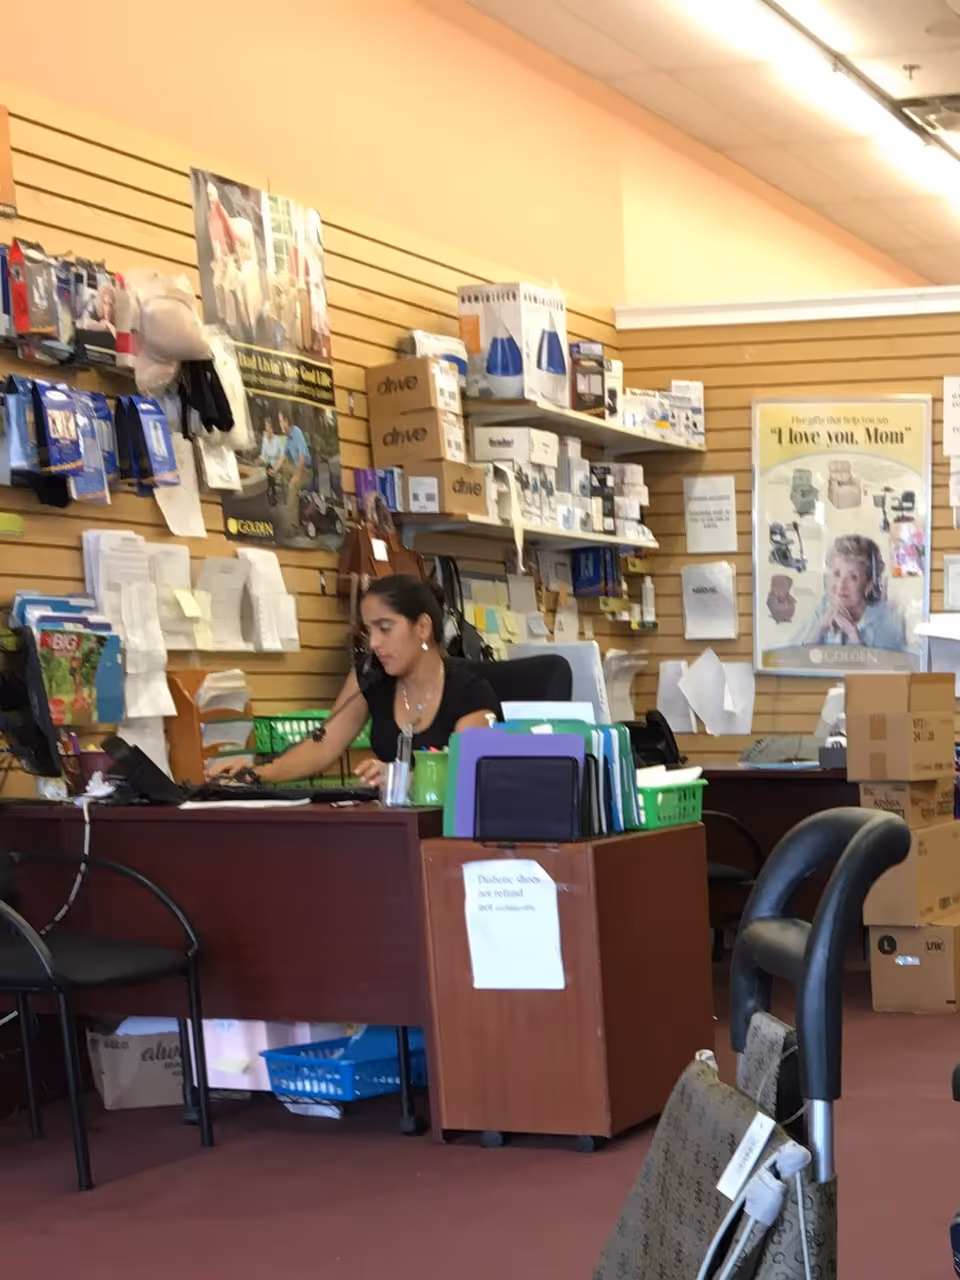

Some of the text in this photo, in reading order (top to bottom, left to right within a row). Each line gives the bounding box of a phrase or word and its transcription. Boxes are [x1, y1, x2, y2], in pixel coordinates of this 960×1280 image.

[283, 360, 299, 378] the
[376, 376, 418, 396] drive
[808, 415, 825, 425] gifts
[826, 415, 842, 424] that
[843, 415, 858, 425] help
[860, 417, 875, 425] you
[877, 417, 889, 425] say
[382, 427, 427, 447] drive
[789, 427, 820, 445] love
[822, 431, 858, 448] you,
[452, 477, 482, 497] drive
[238, 519, 275, 537] GOLDEN
[494, 888, 524, 898] refund
